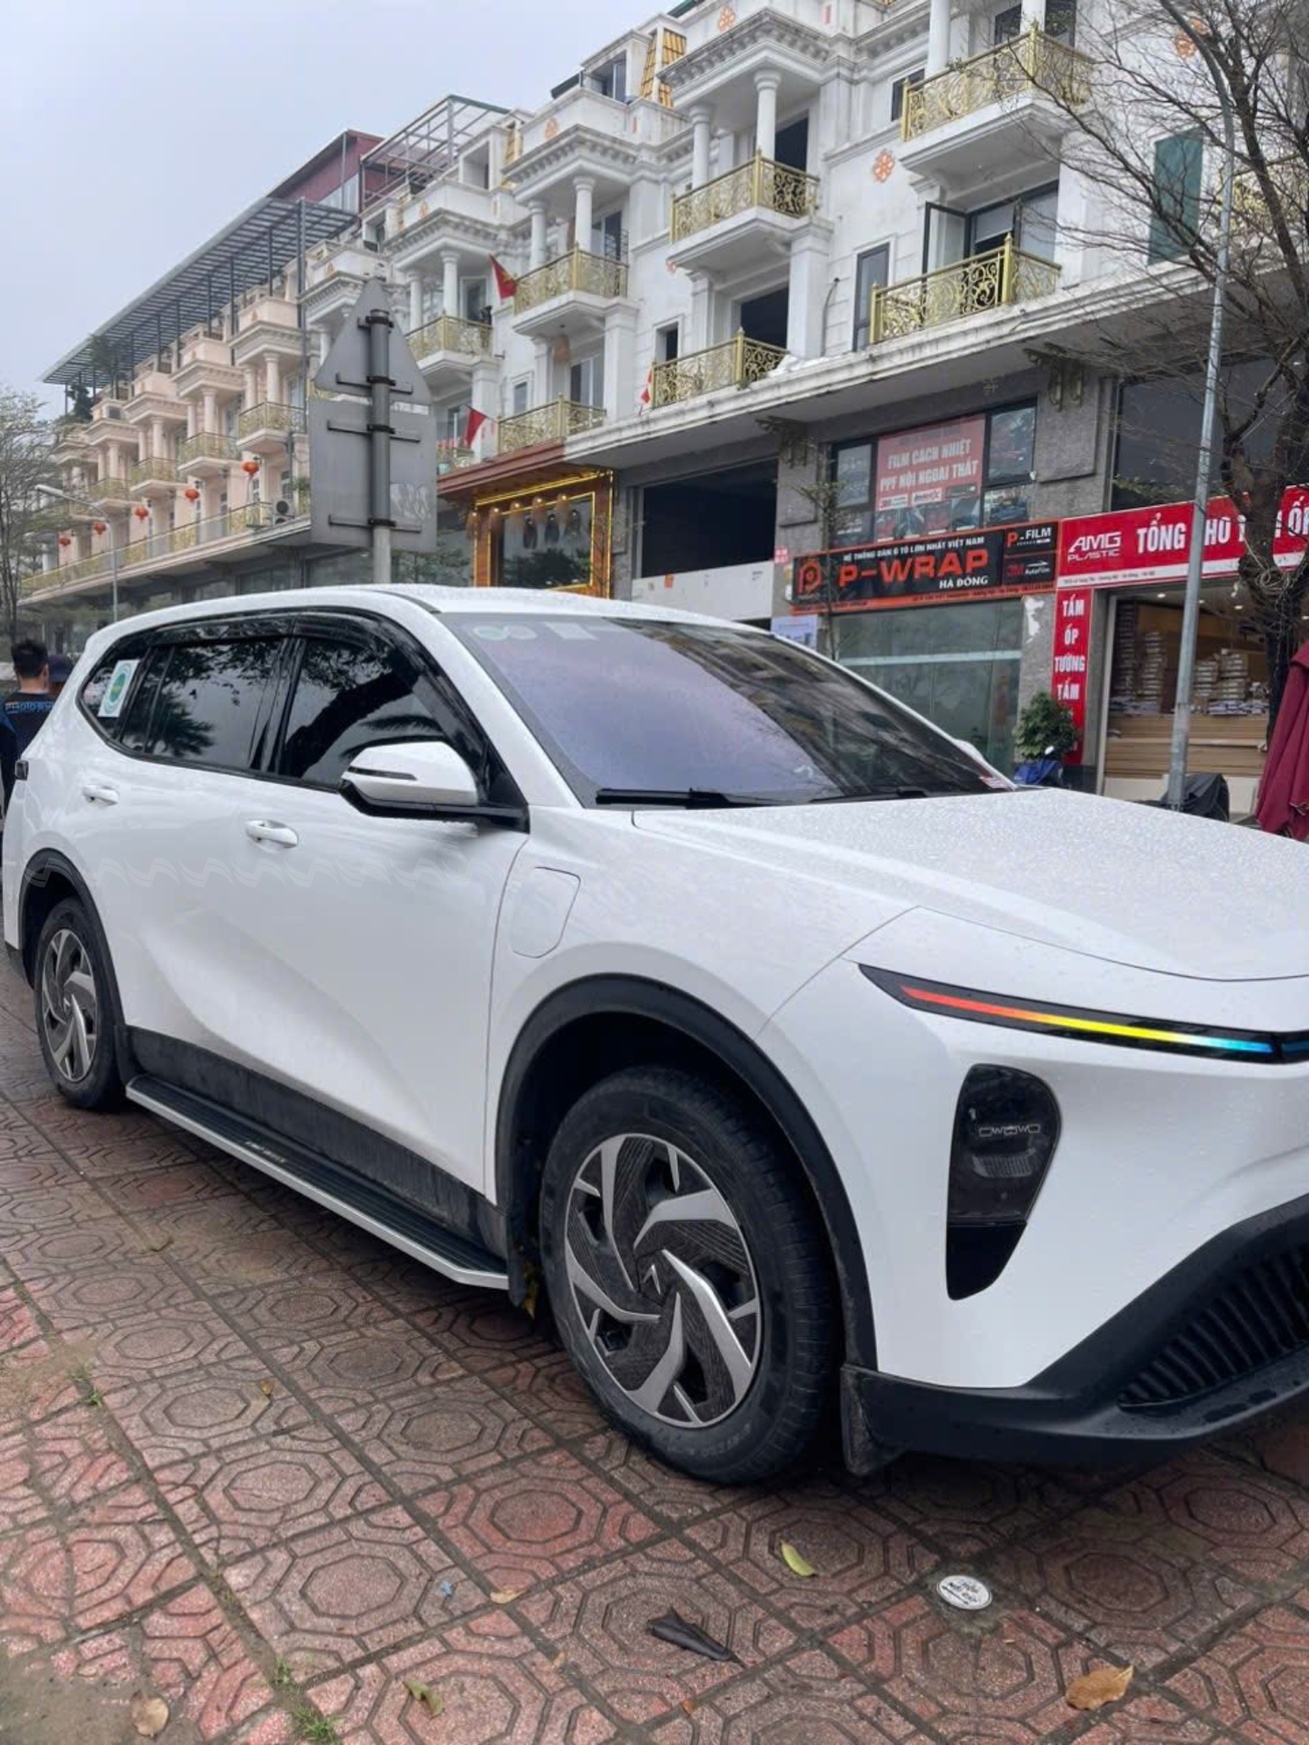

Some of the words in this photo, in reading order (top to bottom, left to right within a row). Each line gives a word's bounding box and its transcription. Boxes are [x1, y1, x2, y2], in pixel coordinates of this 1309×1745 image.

[888, 453, 910, 469] FILM
[965, 536, 985, 546] NAM
[1068, 531, 1121, 553] AMG
[1137, 512, 1186, 554] TỔNG
[1067, 548, 1120, 562] PLASTIC
[837, 548, 989, 588] P-WRAP
[1063, 594, 1084, 617] TẤM
[1064, 623, 1079, 645] ỐP
